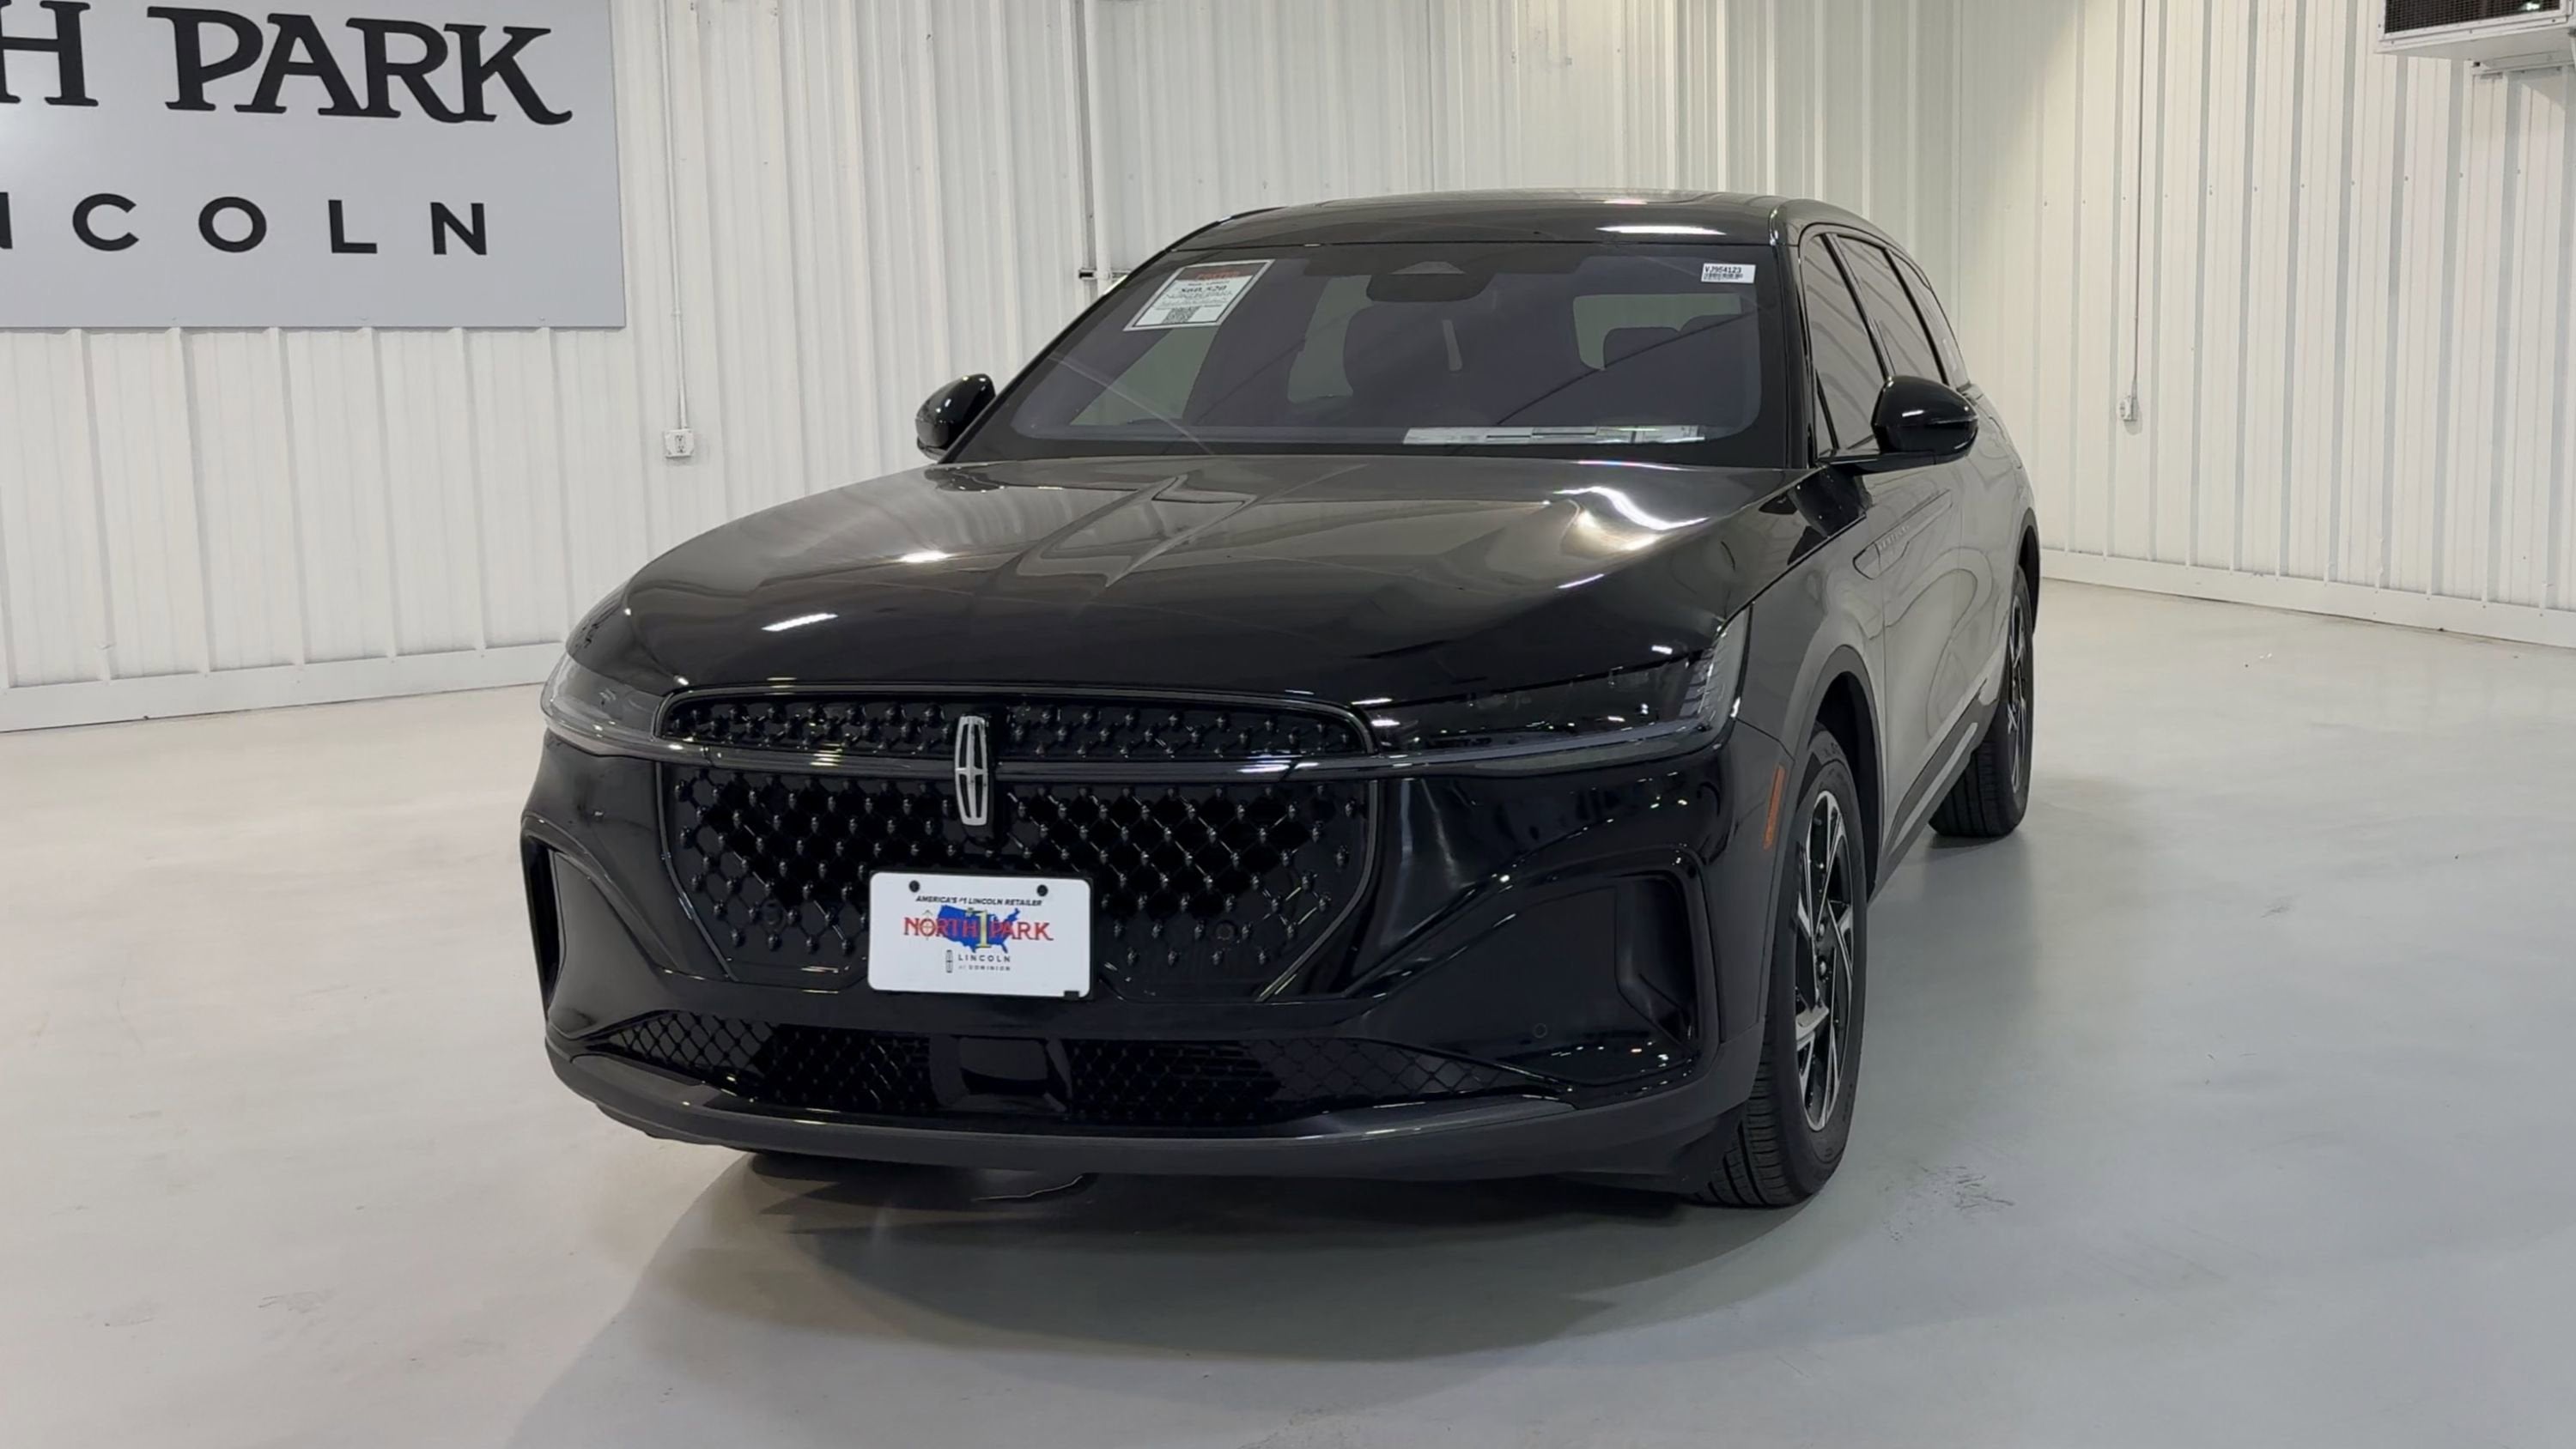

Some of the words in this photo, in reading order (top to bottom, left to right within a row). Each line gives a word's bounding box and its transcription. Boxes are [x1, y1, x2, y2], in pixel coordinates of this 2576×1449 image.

[147, 6, 573, 125] PARK
[0, 191, 488, 256] COLN
[915, 895, 958, 904] AMERICA'S
[903, 917, 978, 937] NORTH
[991, 920, 1054, 942] PARK
